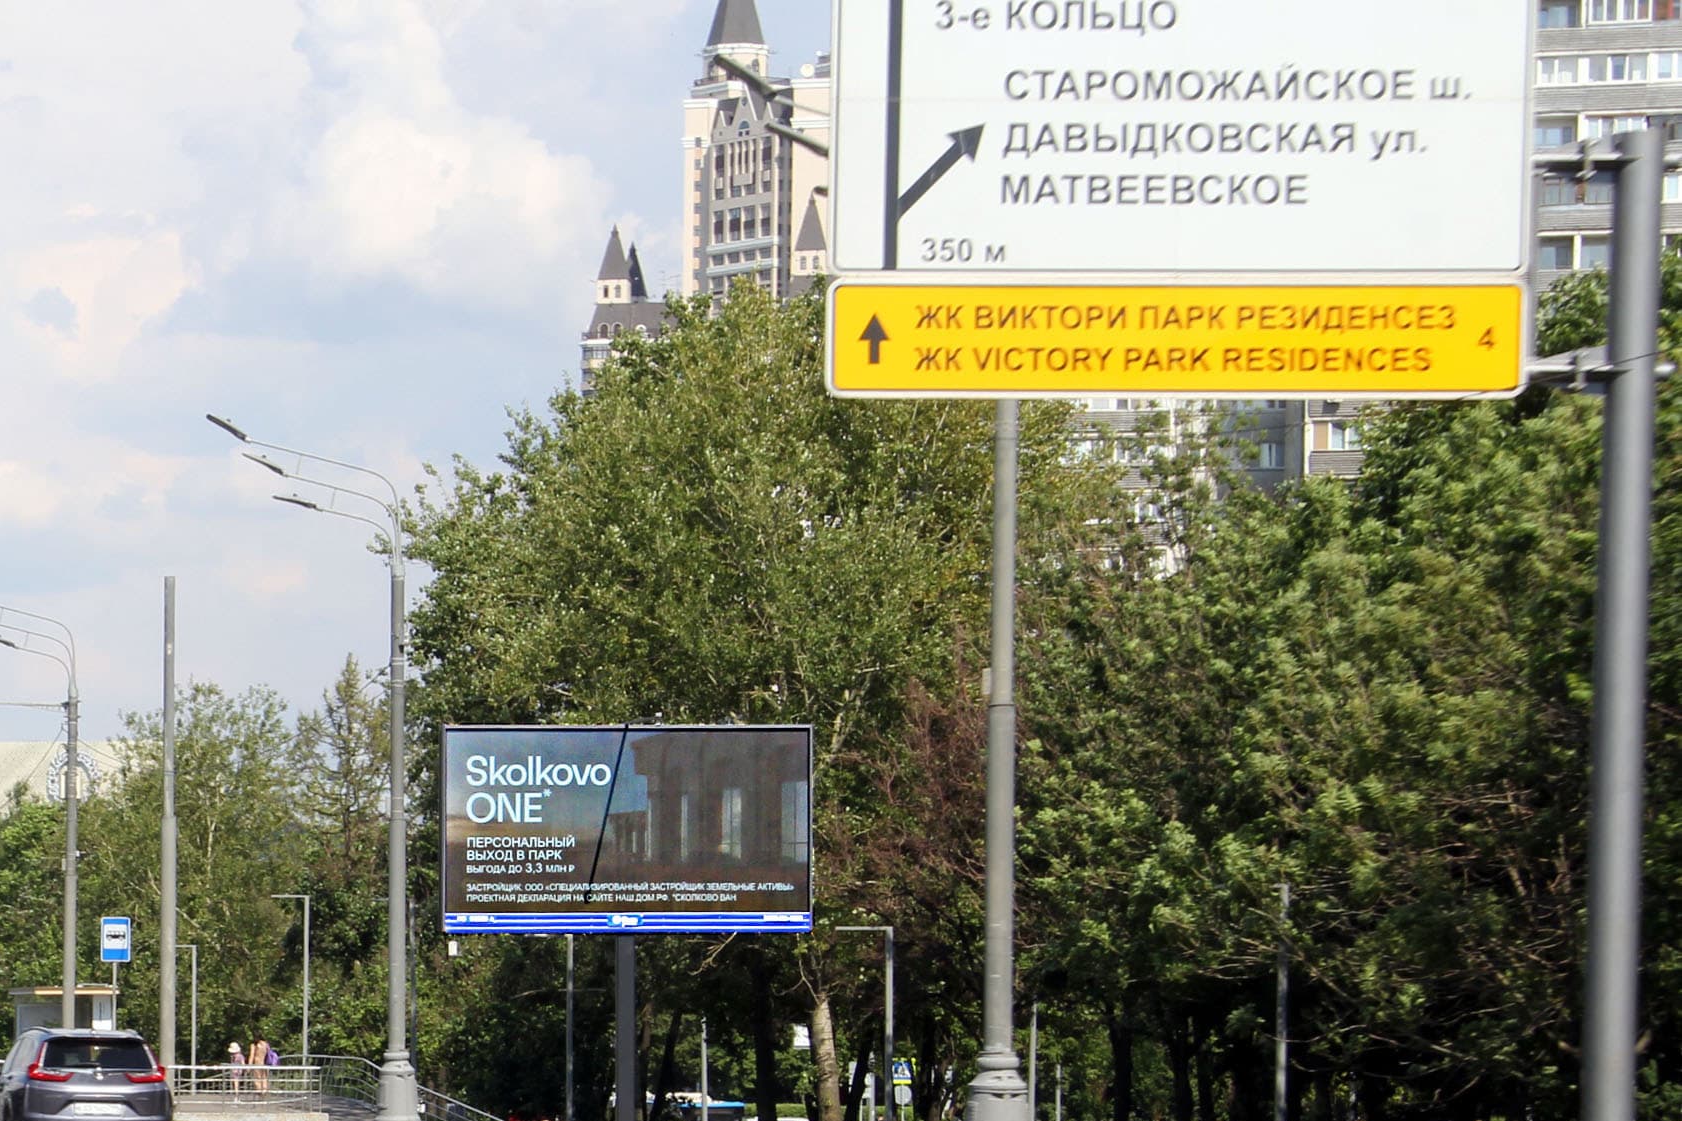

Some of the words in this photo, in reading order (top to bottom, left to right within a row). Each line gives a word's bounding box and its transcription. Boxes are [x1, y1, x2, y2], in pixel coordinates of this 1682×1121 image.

[935, 0, 990, 30] 3-е
[1006, 0, 1177, 36] КОЛЬЦО
[1004, 63, 1416, 101] СТАРОМОЖАЙСКОЕ
[1429, 76, 1472, 101] ш.
[1002, 122, 1356, 159] ДАВЫДКОВСКАЯ
[1369, 129, 1429, 161] ул.
[1000, 174, 1309, 205] МАТВЕЕВСКОЕ
[921, 238, 973, 262] 350
[984, 244, 1006, 263] м
[914, 305, 964, 329] ЖК
[974, 305, 1127, 329] ВИКТОРИ
[1139, 305, 1226, 330] ПАРК
[1236, 305, 1456, 334] РЕЗИДЕНСЕЗ
[1477, 326, 1497, 350] 4
[914, 347, 964, 372] ЖК
[972, 347, 1114, 372] VICTORY
[1124, 347, 1211, 372] PARK
[1221, 347, 1432, 372] RESIDENCES
[466, 755, 612, 787] Skolkovo
[466, 835, 576, 848] ПЕРСОНАЛЬНЫЙ
[466, 850, 513, 862] ВЫХОД
[516, 850, 526, 861] В
[528, 850, 562, 861] ПАРК
[466, 864, 507, 874] ВЫГОДА
[508, 864, 523, 874] ДО
[525, 863, 543, 875] 3,3
[546, 864, 567, 873] МЛН
[466, 894, 516, 902] ПРОЕКТНАЯ
[517, 894, 572, 904] ДЕКЛАРАЦИЯ
[586, 892, 613, 902] САЙТЕ
[525, 883, 544, 891] ООО
[650, 881, 705, 892] ЗАСТРОЙЩИК
[706, 882, 755, 891] ЗЕМЕЛЬНЫЕ
